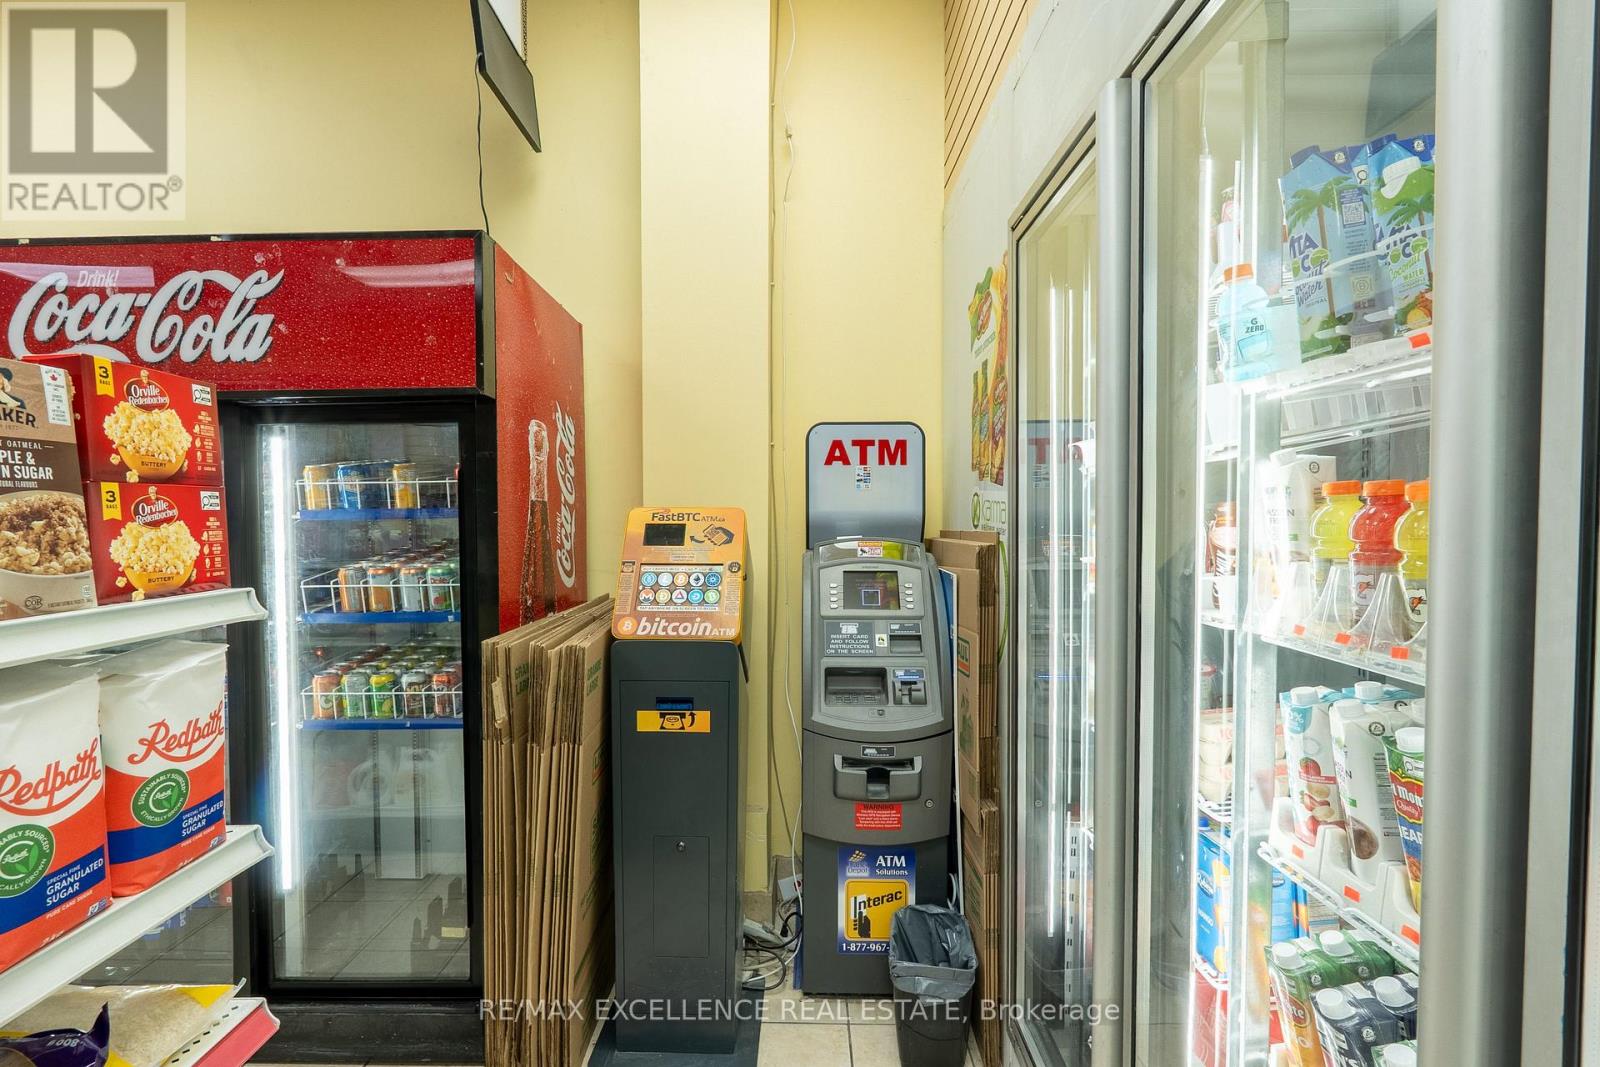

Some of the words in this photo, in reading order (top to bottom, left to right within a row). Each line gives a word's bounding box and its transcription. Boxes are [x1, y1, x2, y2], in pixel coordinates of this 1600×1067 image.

[77, 269, 120, 288] Drink!
[8, 268, 285, 363] Coca-Cola
[1245, 324, 1265, 334] ZERO
[98, 366, 110, 379] 3
[131, 384, 161, 397] Orville
[0, 406, 36, 429] KER
[7, 441, 43, 450] OATMEAL
[824, 439, 908, 466] ATM
[26, 451, 36, 466] &
[141, 461, 167, 469] BUTTERY
[14, 465, 54, 481] SUGAR
[105, 490, 117, 503] 3
[555, 400, 577, 589] Coca-Cola
[139, 500, 169, 516] Orville
[651, 512, 701, 522] FastBTC
[147, 575, 175, 584] BUTTERY
[636, 616, 712, 636] bitcoin
[711, 627, 737, 636] ATM
[128, 700, 225, 765] Redpath
[182, 800, 224, 829] GRANULATED
[182, 818, 206, 837] SUGAR
[876, 855, 906, 867] ATM
[46, 870, 68, 885] SPECIAL
[68, 864, 81, 876] FINE
[46, 858, 104, 896] GRANULATED
[46, 883, 80, 907] SUGAR
[853, 890, 902, 919] Interac
